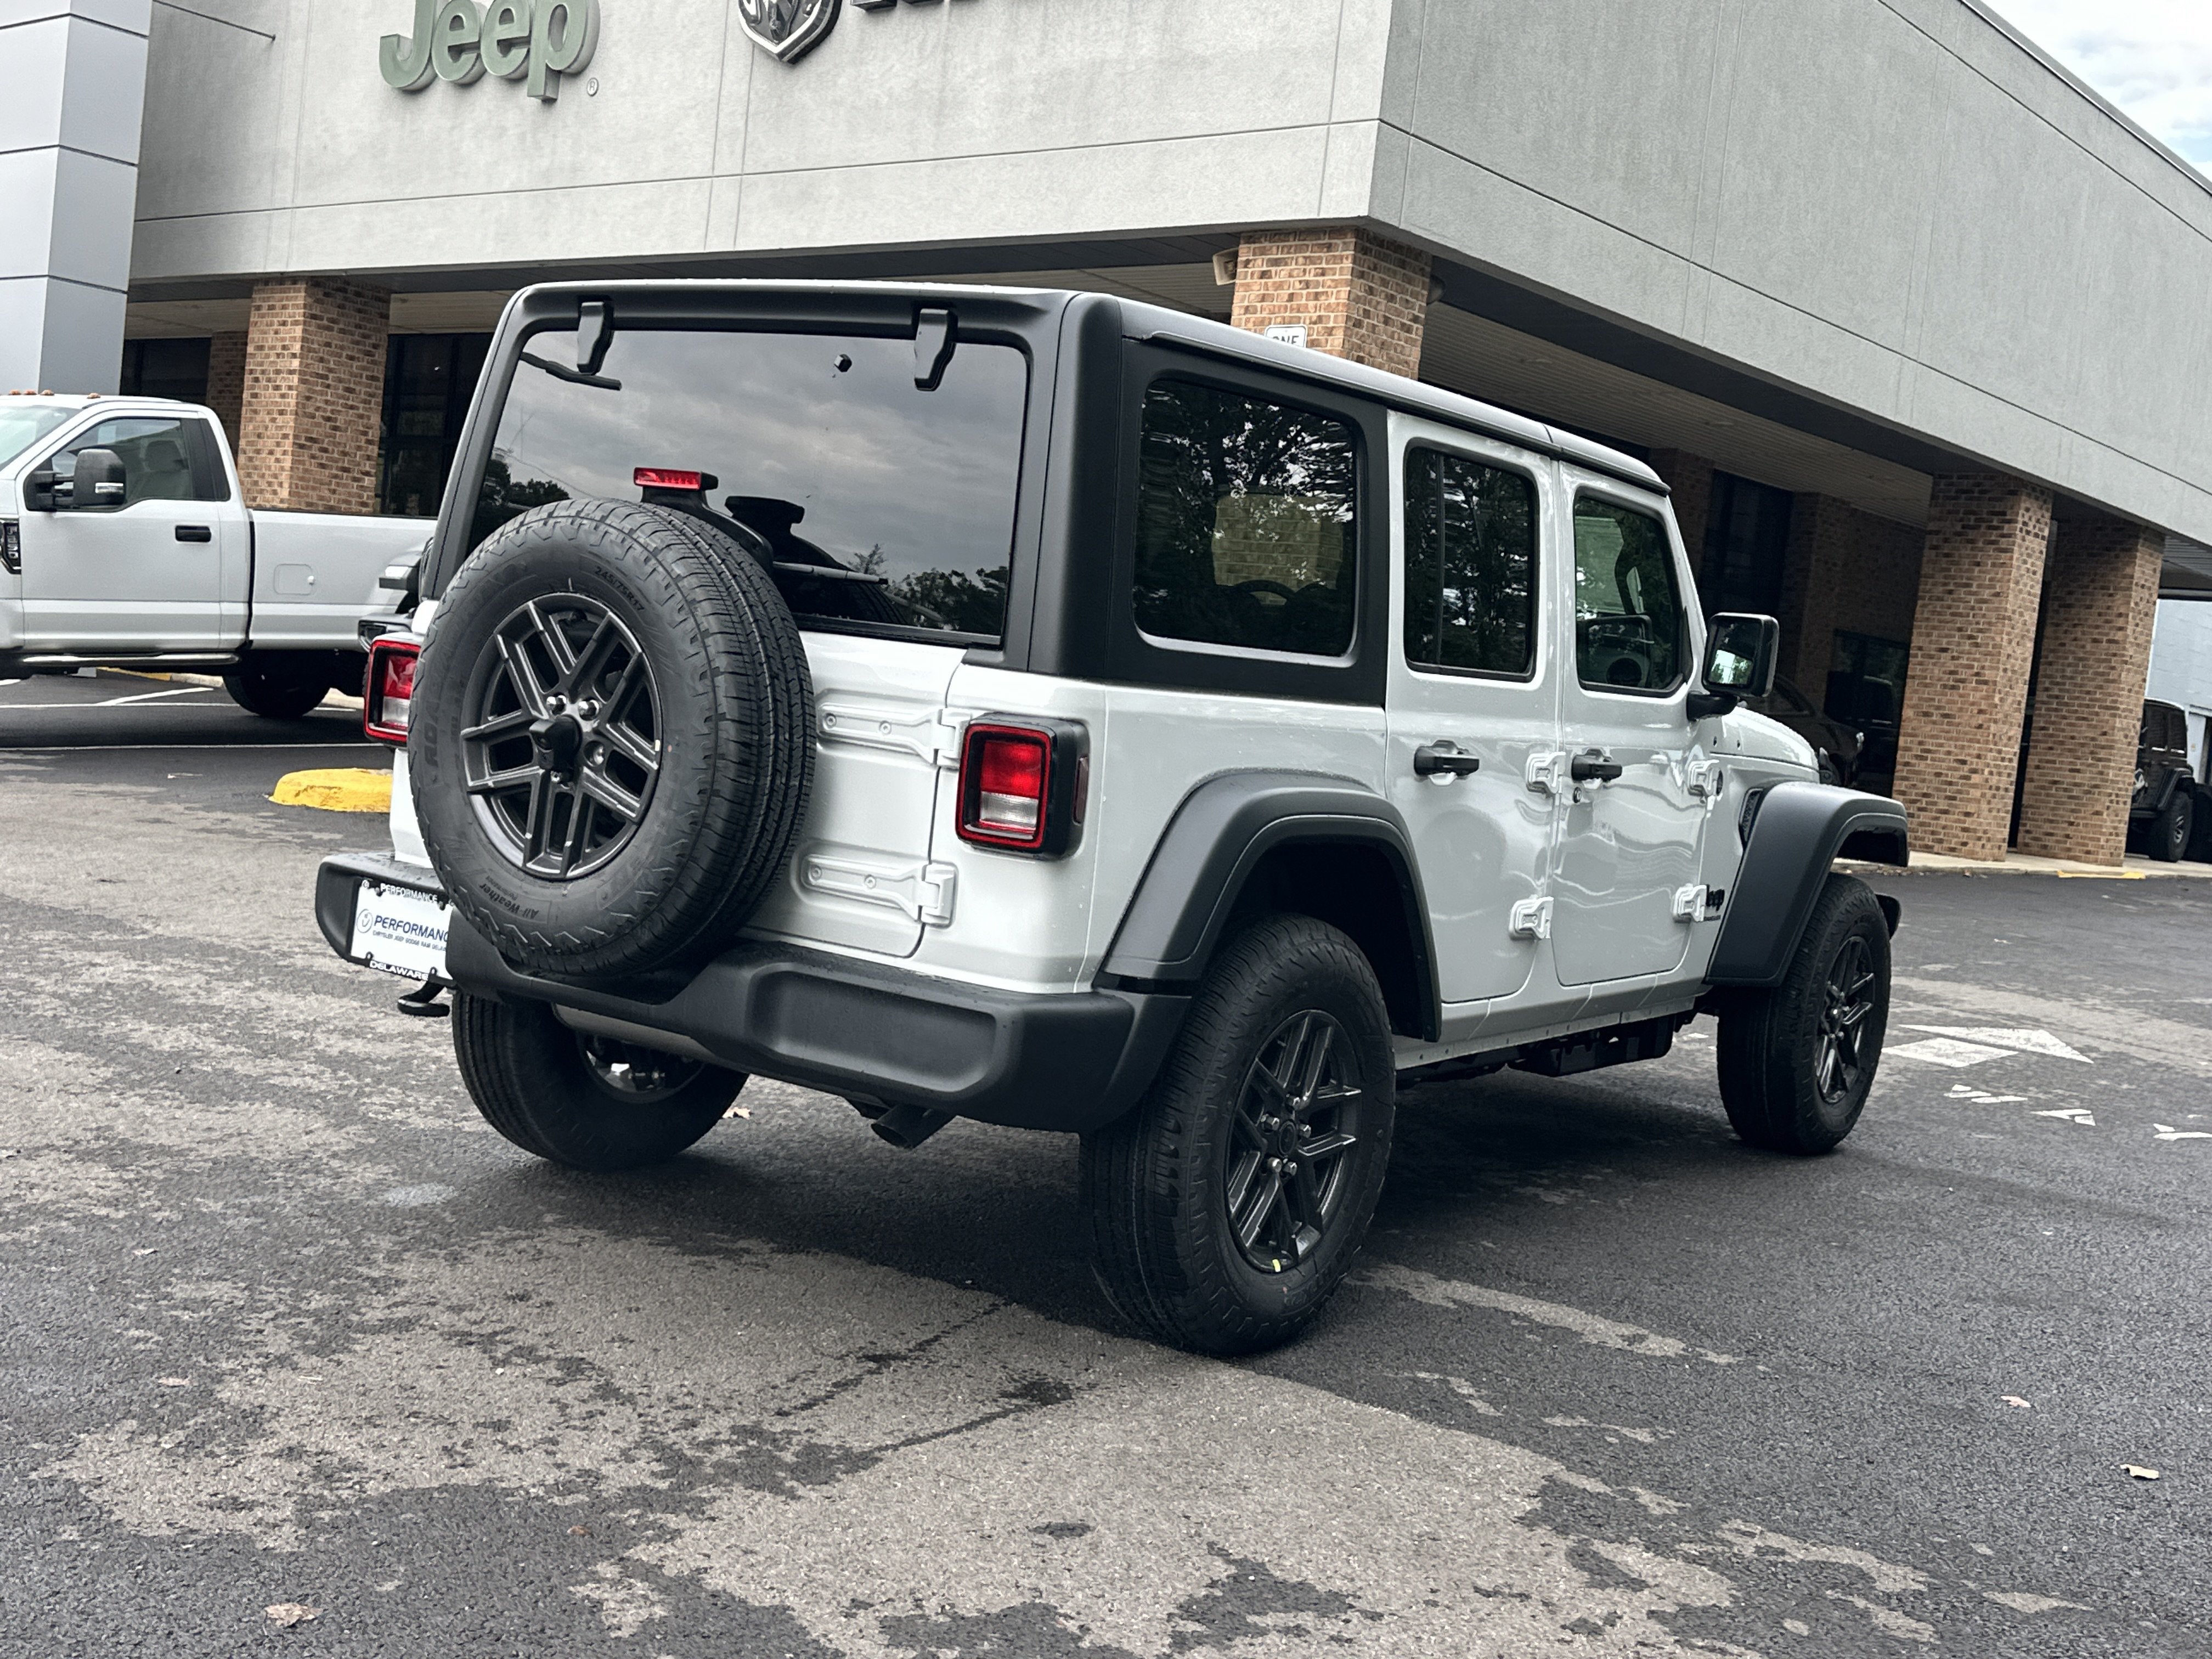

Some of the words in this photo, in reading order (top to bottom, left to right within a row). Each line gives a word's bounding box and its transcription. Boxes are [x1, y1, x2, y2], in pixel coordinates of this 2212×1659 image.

[379, 0, 600, 100] Jeep
[380, 883, 438, 902] PERFORMANCE
[374, 914, 449, 943] PERFORMANC
[369, 961, 428, 980] DELAWARE
